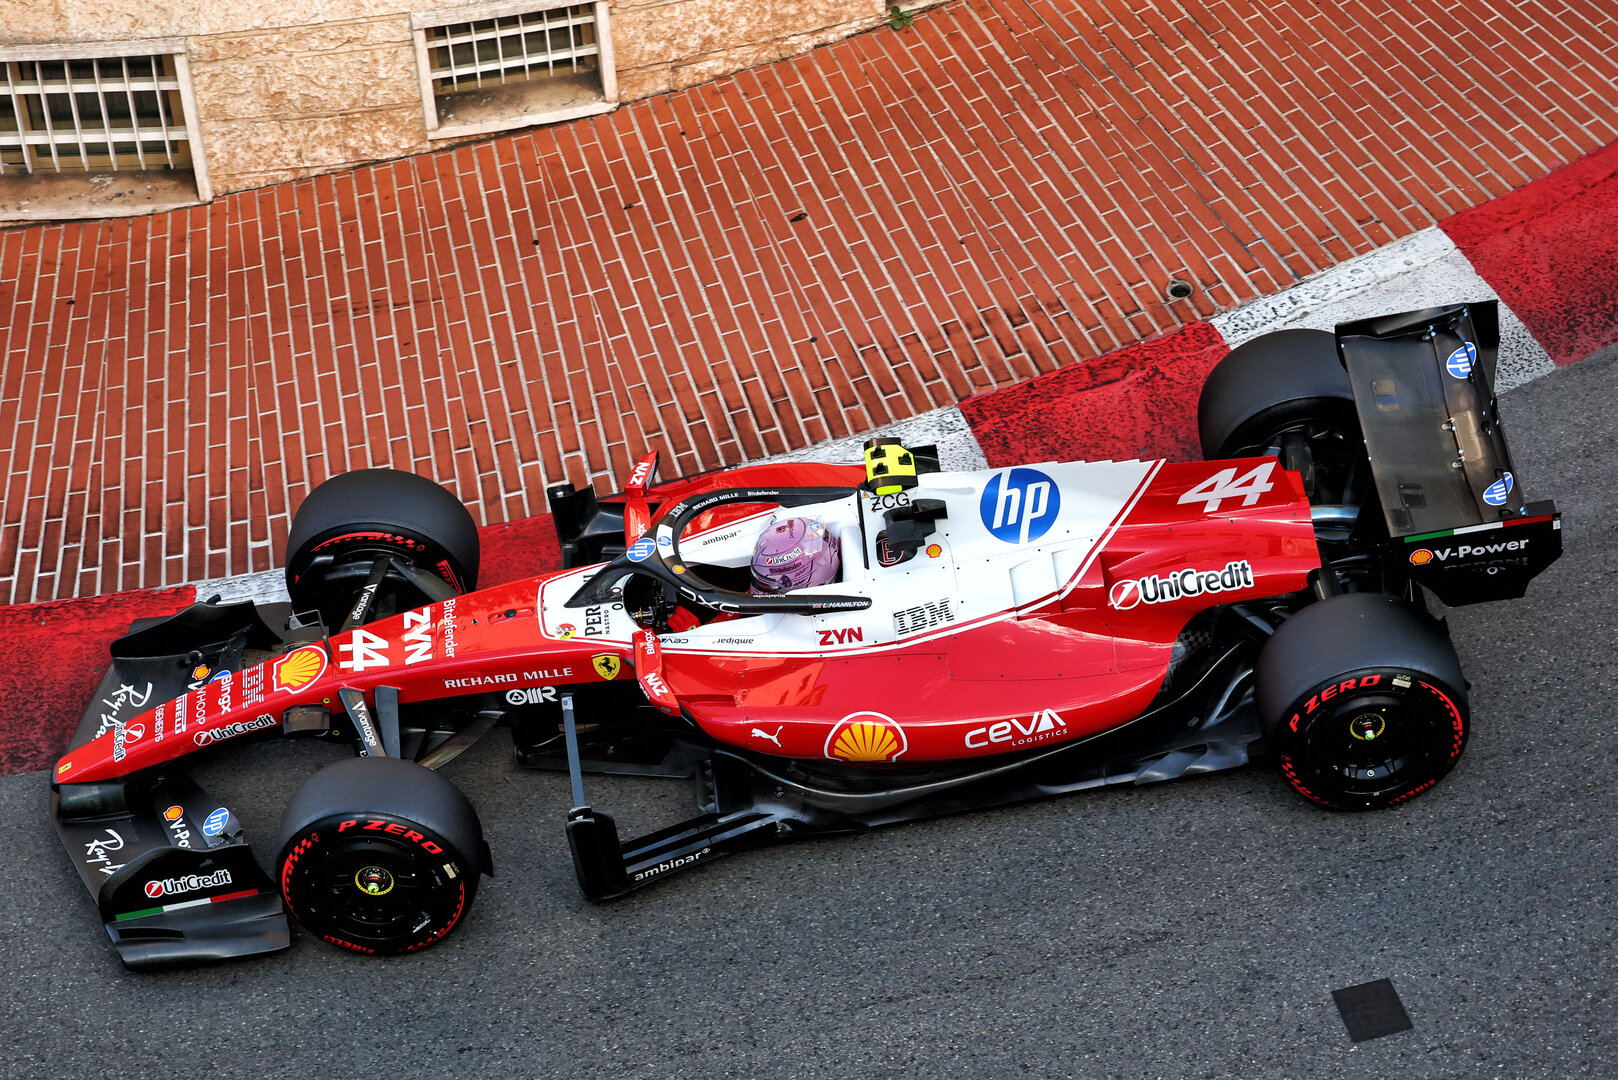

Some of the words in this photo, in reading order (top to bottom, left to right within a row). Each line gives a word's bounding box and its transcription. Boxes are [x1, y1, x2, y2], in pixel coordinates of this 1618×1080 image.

[630, 462, 650, 485] ZYN
[1177, 460, 1277, 513] 44
[668, 502, 688, 518] IBM
[692, 497, 718, 511] RICHARD
[719, 492, 739, 501] MILLE
[1434, 539, 1529, 561] V-Power
[1140, 560, 1254, 603] UniCredit
[352, 592, 370, 620] vantage
[893, 597, 955, 635] IBM
[403, 606, 433, 665] ZYN
[443, 598, 459, 658] Bitdefender
[818, 626, 863, 646] ZYN
[339, 629, 390, 672] 44
[242, 662, 265, 709] IBM
[444, 673, 518, 689] RICHARD
[523, 667, 573, 681] MILLE
[644, 672, 669, 697] ZYN
[195, 685, 206, 724] WHOOP
[1289, 713, 1300, 732] P
[1304, 674, 1382, 715] ZERO
[155, 707, 164, 742] GENESYS
[210, 713, 277, 741] UniCredit
[357, 712, 378, 747] vantage
[1012, 728, 1068, 746] LOGISTICS
[338, 820, 357, 832] P
[363, 820, 443, 855] ZERO
[163, 869, 232, 894] UniCredit
